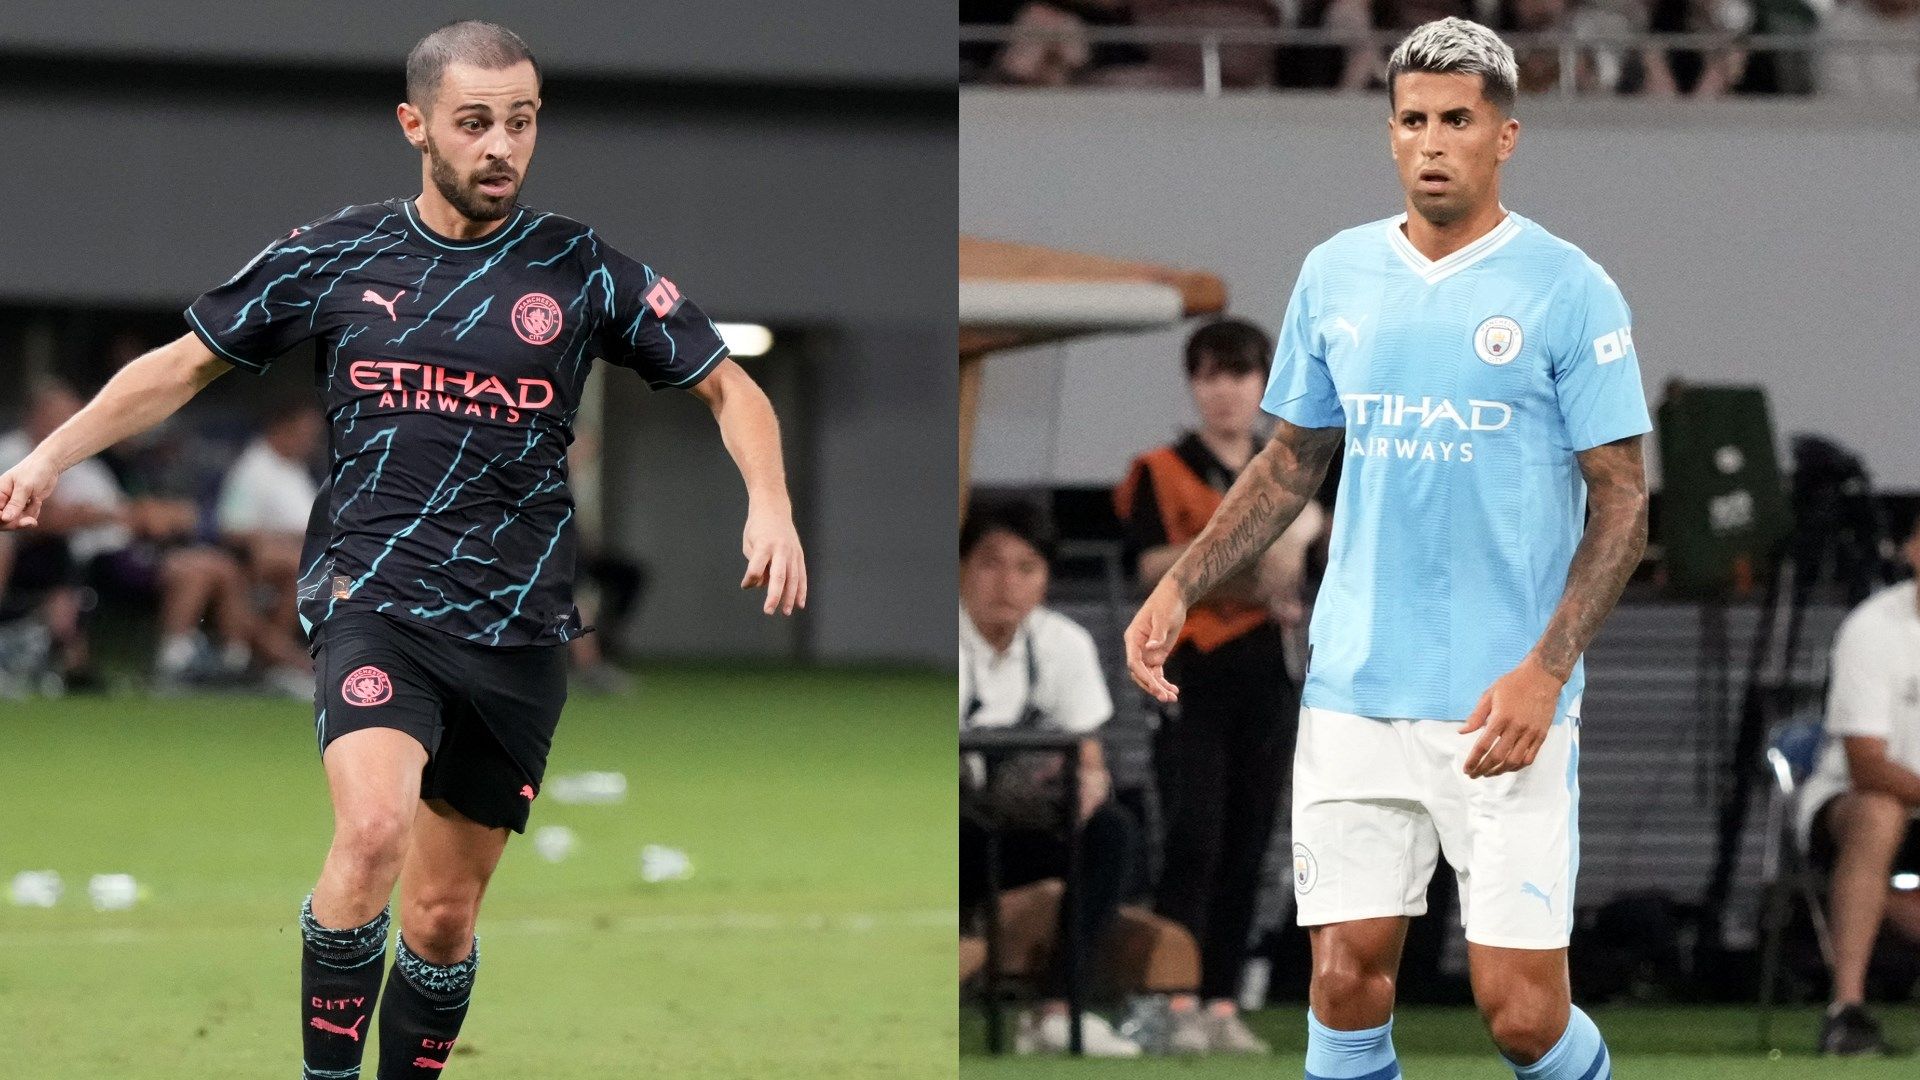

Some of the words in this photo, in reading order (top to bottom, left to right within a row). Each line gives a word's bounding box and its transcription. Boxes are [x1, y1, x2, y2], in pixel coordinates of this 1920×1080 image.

[519, 297, 558, 315] MANCHESTER
[350, 360, 554, 409] ETIHAD
[378, 391, 520, 423] AIRWAYS
[1342, 393, 1512, 430] TIHAD
[1350, 437, 1473, 463] AIRWAYS
[311, 996, 364, 1010] CITY
[421, 1038, 455, 1050] CIT
